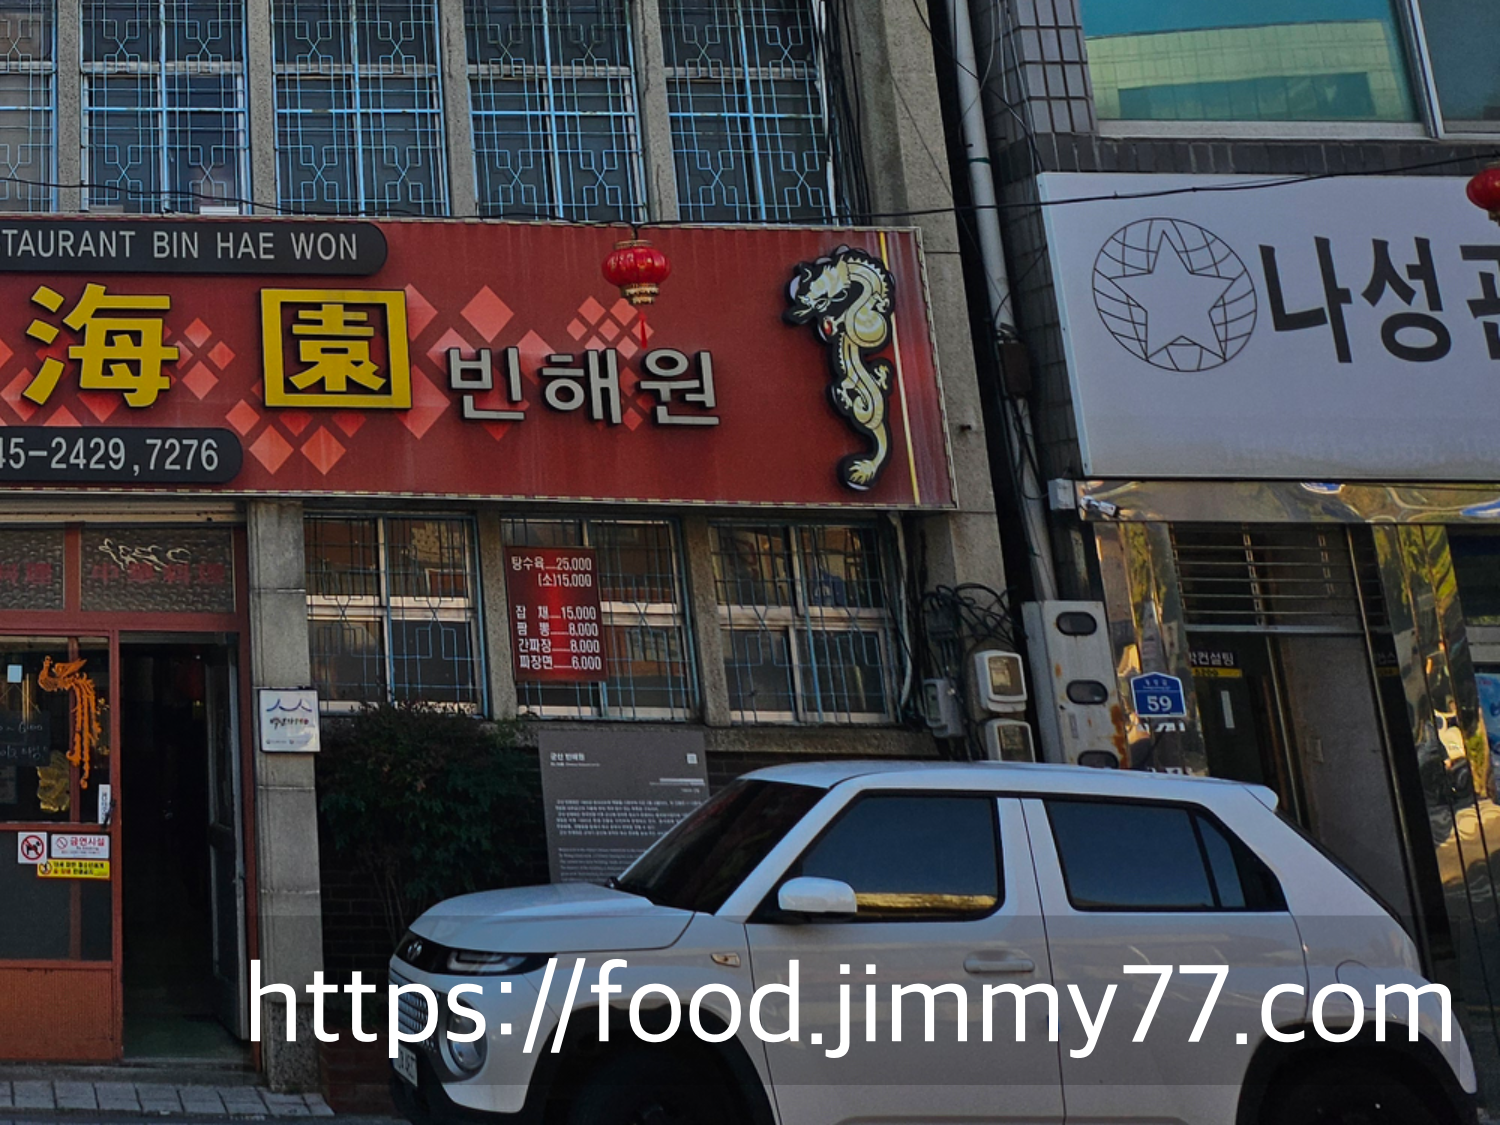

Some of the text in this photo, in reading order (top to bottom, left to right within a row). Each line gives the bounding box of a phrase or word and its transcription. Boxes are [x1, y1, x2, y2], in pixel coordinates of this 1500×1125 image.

[152, 230, 200, 260] BIN
[216, 231, 275, 261] HAE
[290, 231, 359, 262] WON
[446, 346, 720, 426] 빈해원
[511, 555, 545, 571] 탕수육
[1146, 695, 1173, 712] 59
[70, 836, 105, 847] 금연시설
